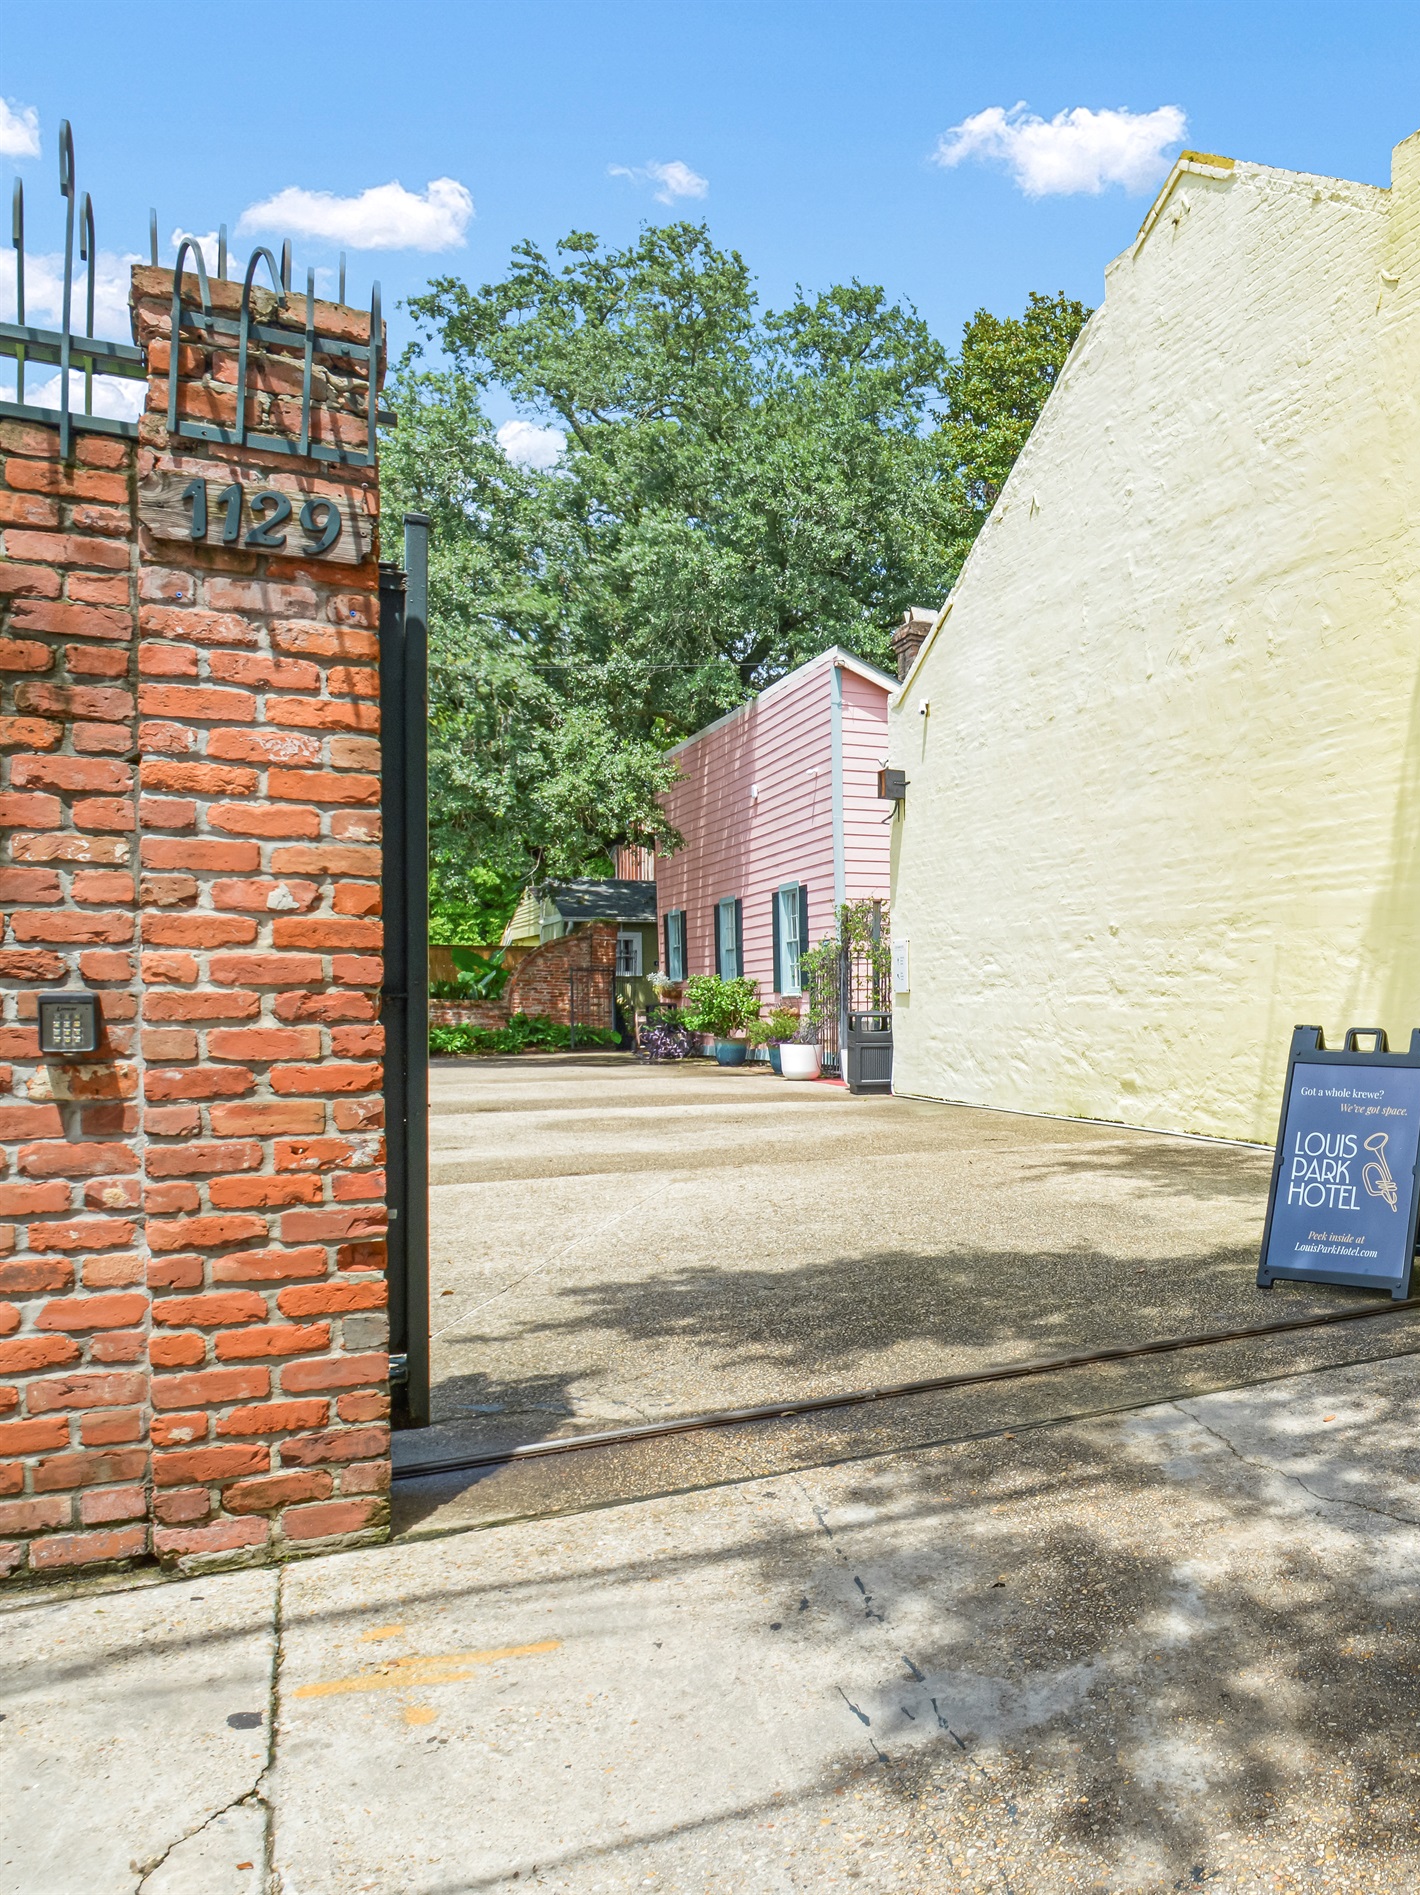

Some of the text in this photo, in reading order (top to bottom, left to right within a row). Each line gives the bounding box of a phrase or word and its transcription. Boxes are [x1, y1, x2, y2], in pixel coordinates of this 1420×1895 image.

[182, 478, 342, 554] 1129
[1301, 1086, 1316, 1096] Got
[1325, 1088, 1351, 1098] whole
[1352, 1089, 1385, 1099] krewe?
[1340, 1103, 1408, 1117] We've got space.
[1295, 1131, 1358, 1158] LOUIS
[1291, 1157, 1351, 1184] PARK
[1287, 1182, 1360, 1210] HOTEL
[1308, 1230, 1365, 1244] Peek inside at
[1294, 1242, 1378, 1258] LouisParkHotel.com
